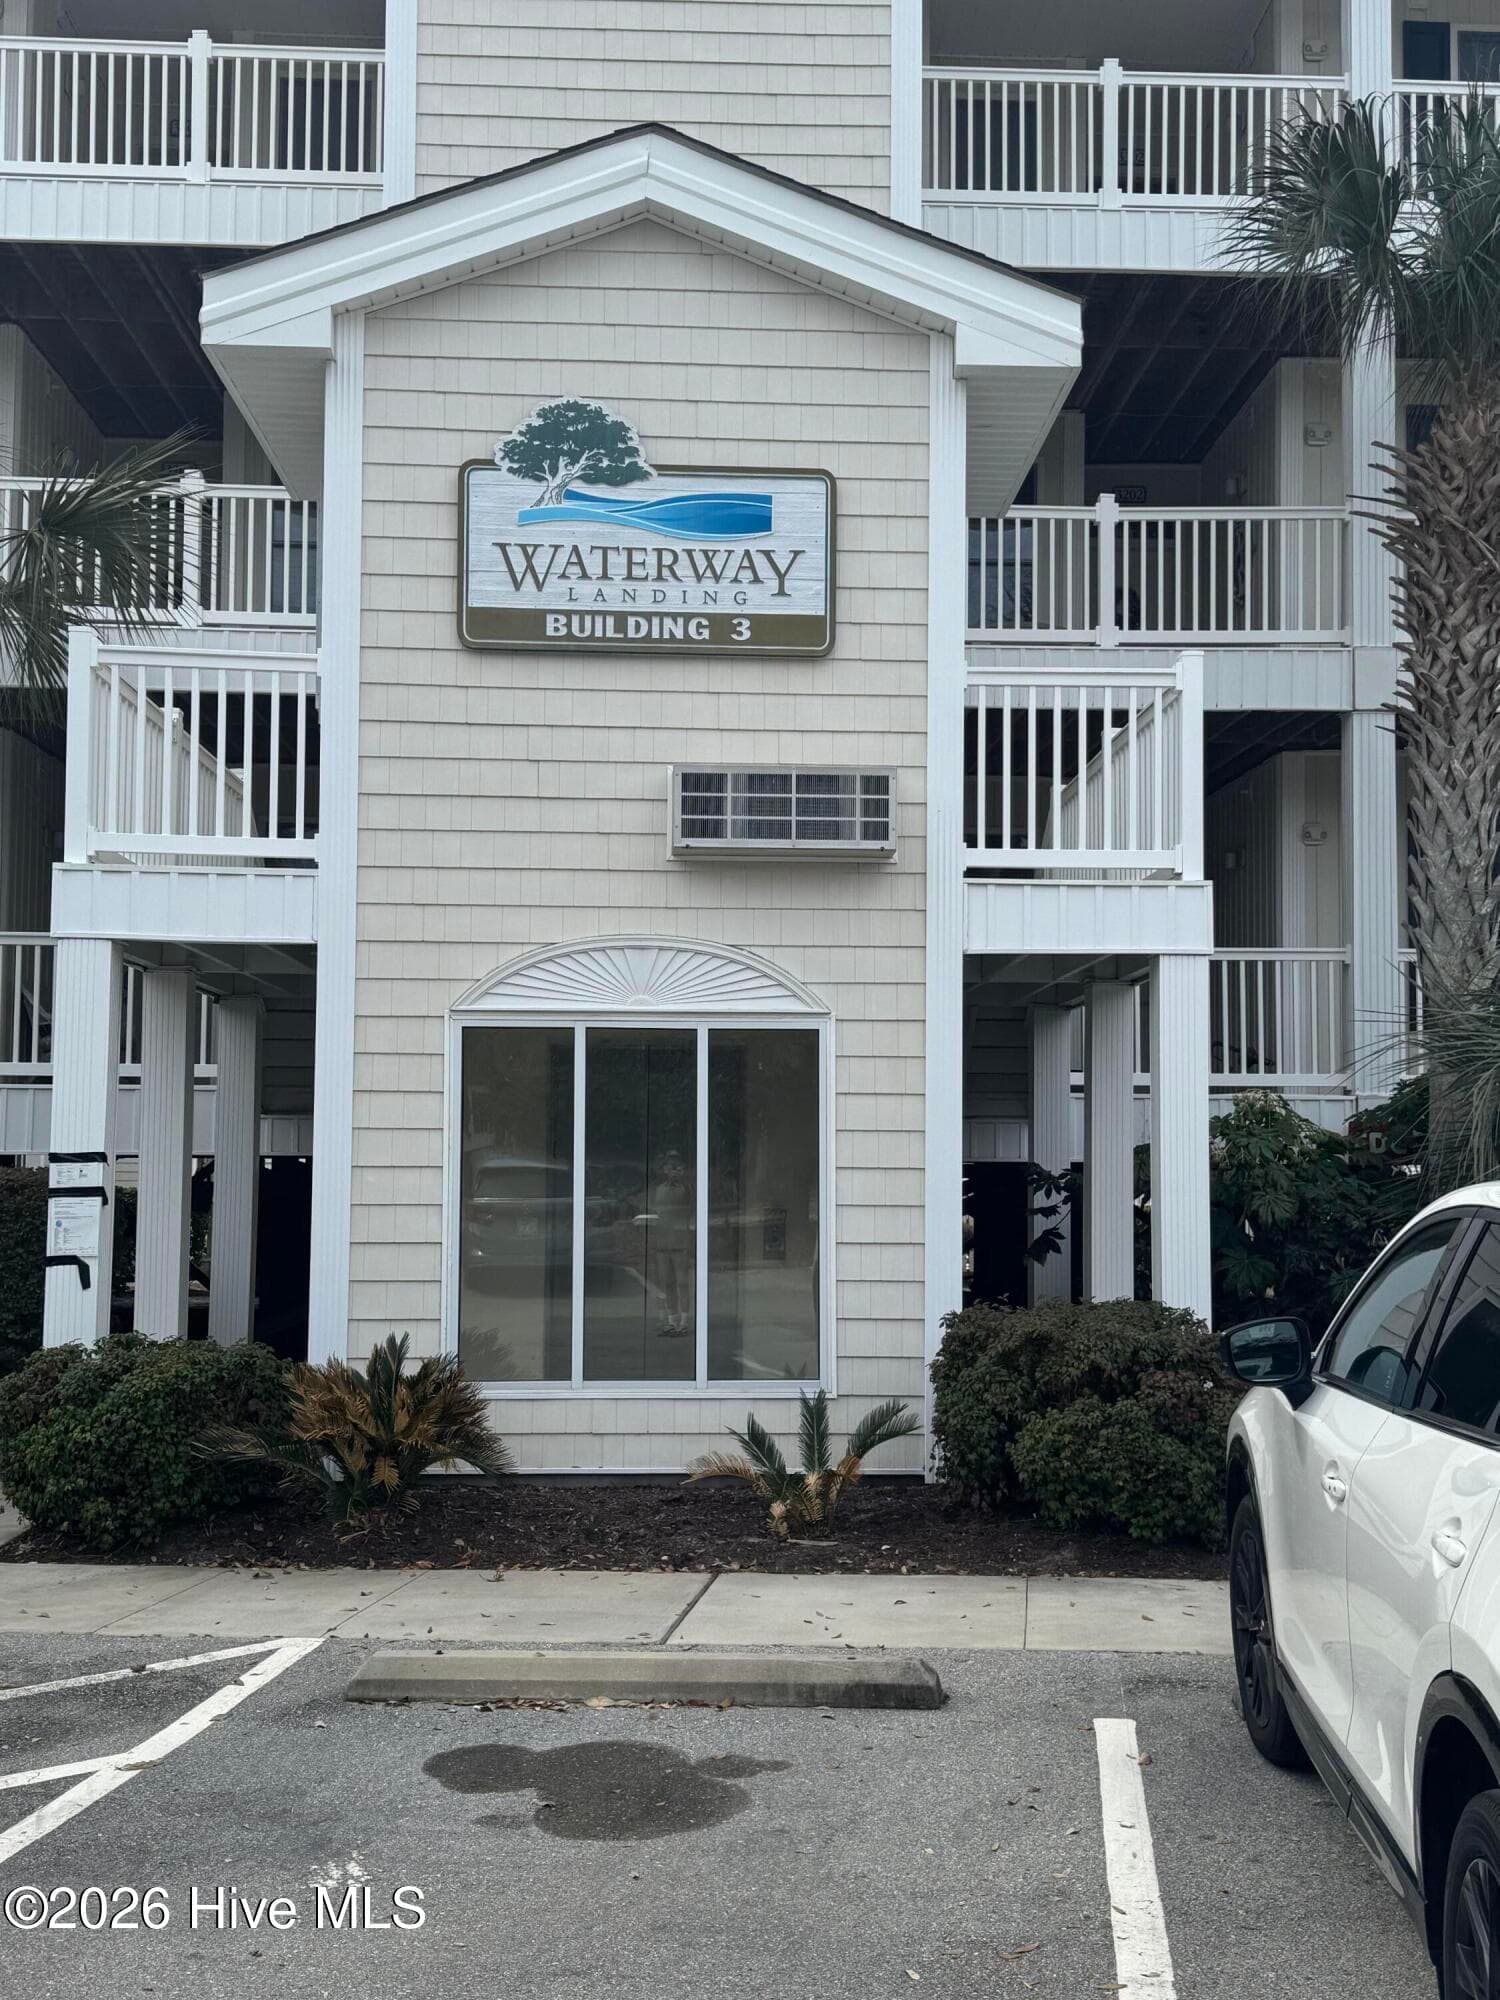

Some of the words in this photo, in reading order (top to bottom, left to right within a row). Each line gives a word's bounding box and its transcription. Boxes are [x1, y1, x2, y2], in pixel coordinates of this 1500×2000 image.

[491, 542, 806, 597] WATERWAY
[567, 587, 749, 605] LANDING
[545, 613, 711, 640] BUILDING
[730, 617, 752, 641] 3
